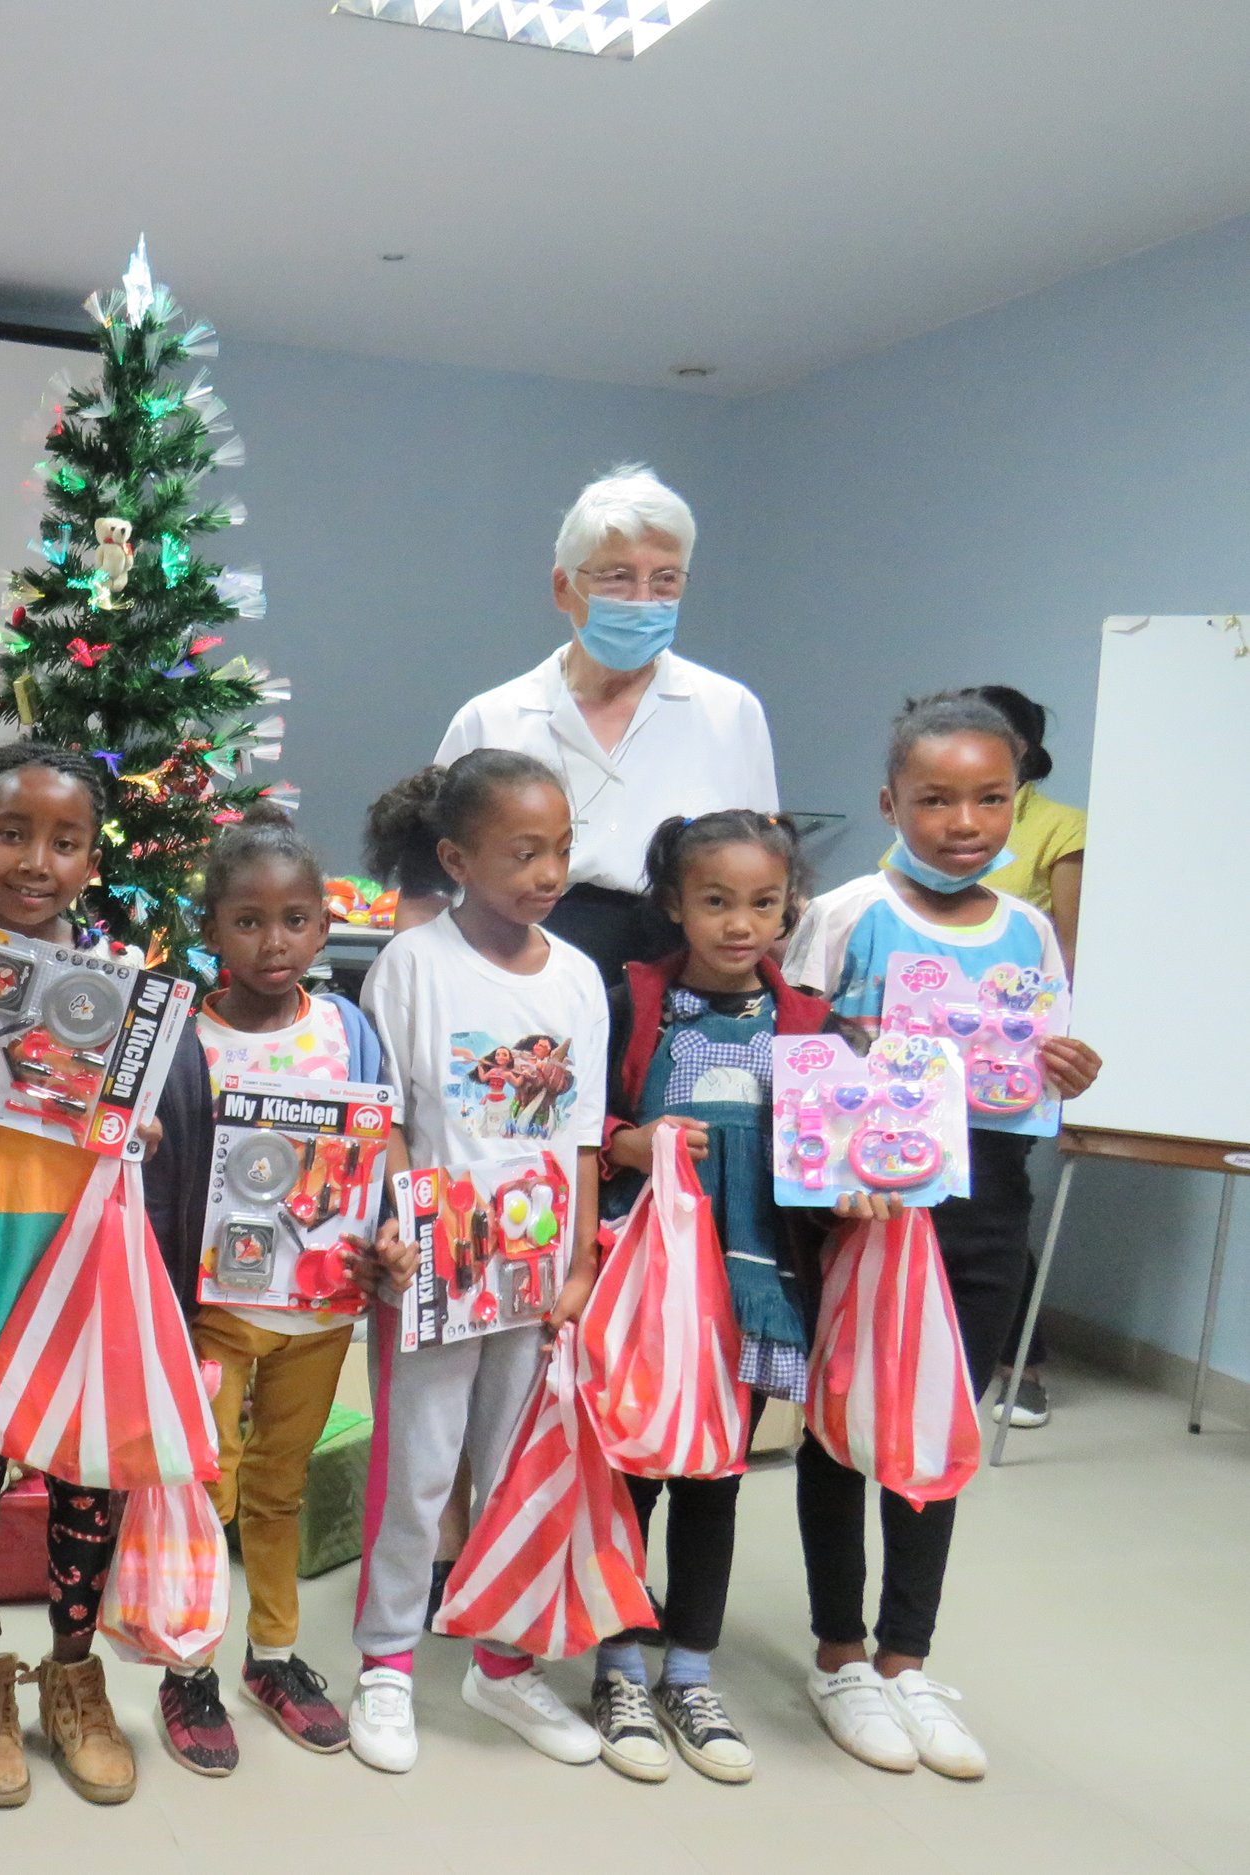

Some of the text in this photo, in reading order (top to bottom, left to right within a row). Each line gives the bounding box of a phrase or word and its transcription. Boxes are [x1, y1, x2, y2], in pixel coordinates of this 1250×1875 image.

[137, 978, 170, 1014] My
[899, 971, 949, 993] PONY
[112, 1017, 158, 1098] Kitchen
[786, 1049, 836, 1075] PONY
[225, 1094, 339, 1126] My Kitchen
[418, 1223, 436, 1341] My Kitchen
